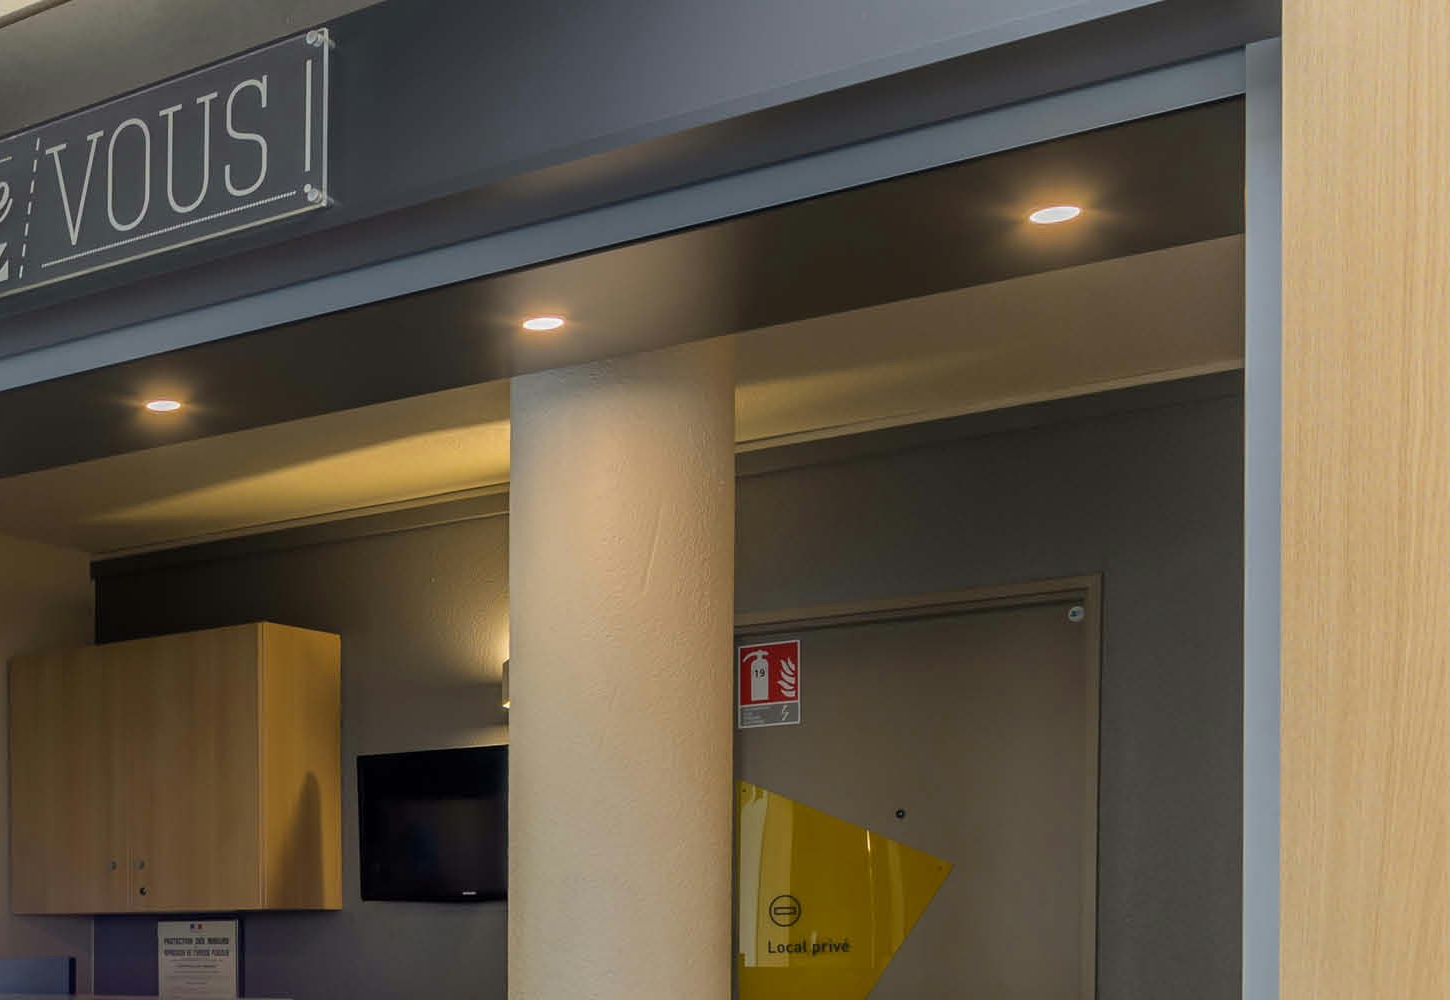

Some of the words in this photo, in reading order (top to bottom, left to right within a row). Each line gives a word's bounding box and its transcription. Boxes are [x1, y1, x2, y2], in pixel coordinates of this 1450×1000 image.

[44, 74, 268, 246] VOUS
[754, 668, 766, 680] 19
[767, 939, 807, 955] Local
[812, 938, 851, 957] privé
